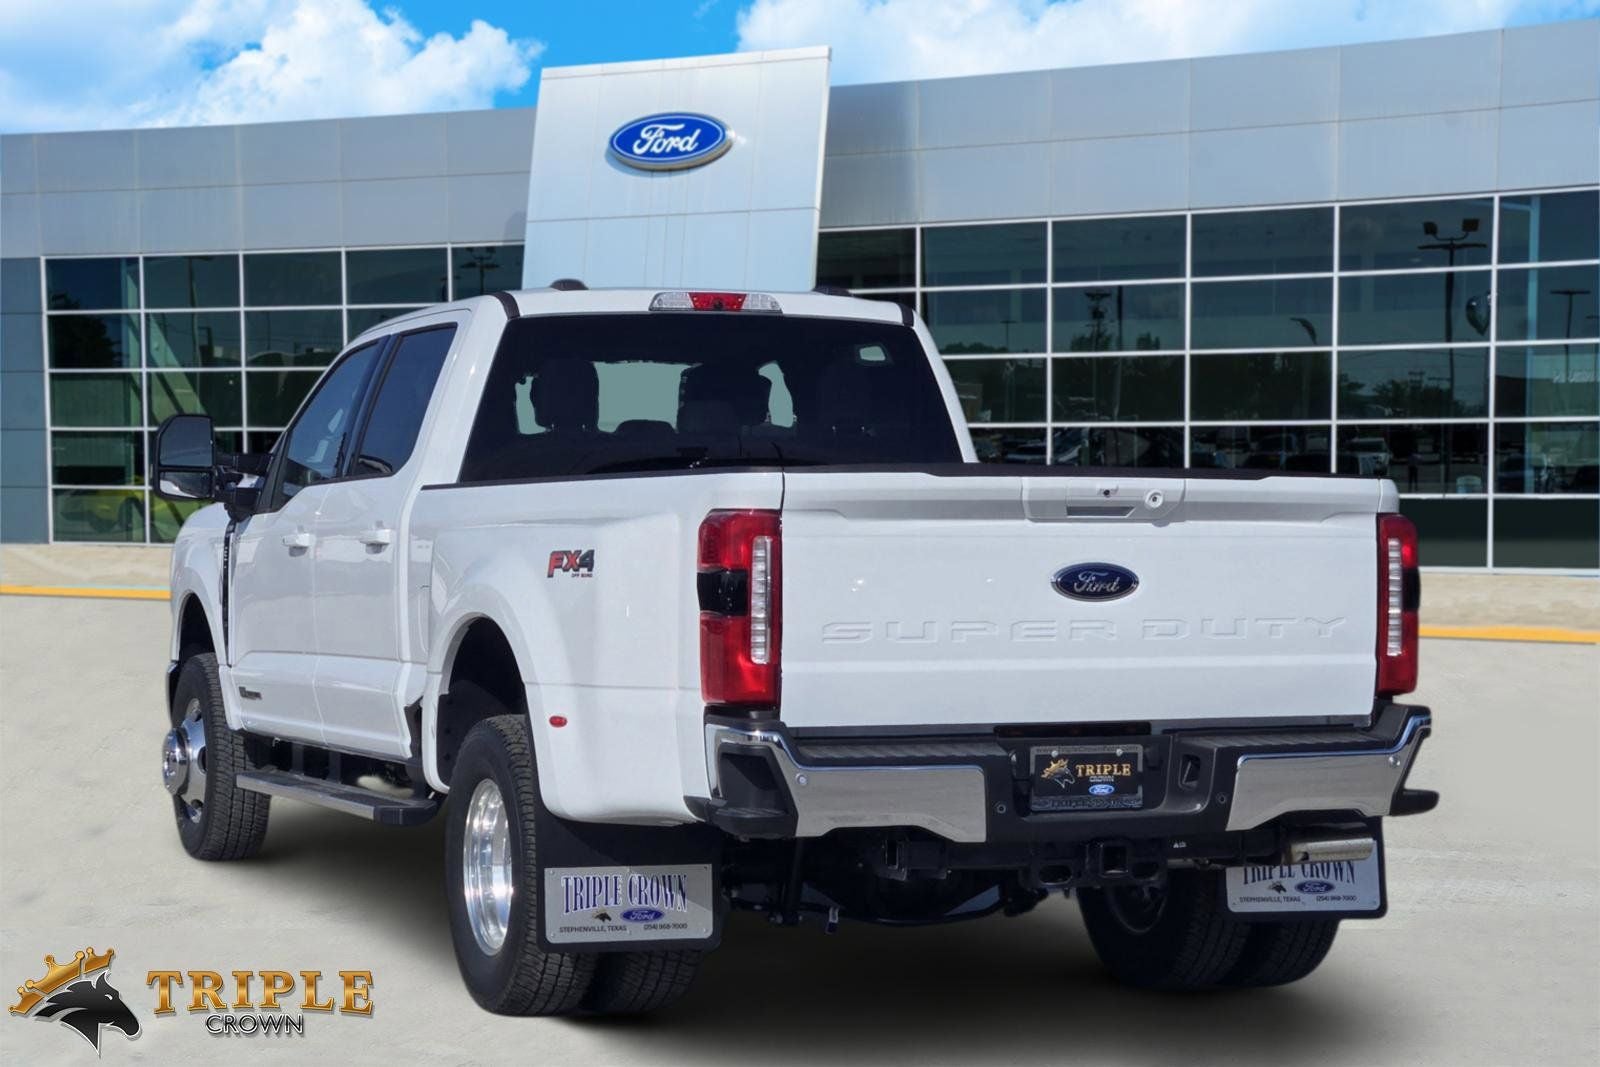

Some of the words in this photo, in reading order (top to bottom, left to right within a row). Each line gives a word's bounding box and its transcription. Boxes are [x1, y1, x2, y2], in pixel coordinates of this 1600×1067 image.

[632, 123, 701, 155] Ford
[547, 549, 595, 578] FX4
[1073, 571, 1120, 592] Ford
[822, 619, 1117, 644] SUPER
[1142, 616, 1347, 640] DUTY
[1075, 763, 1132, 777] TRIPLE
[561, 874, 622, 914] TRIPLE
[628, 873, 688, 912] CROWN
[1302, 882, 1326, 893] Ford
[629, 909, 655, 920] Ford
[559, 925, 607, 933] STEPHENVILLE,
